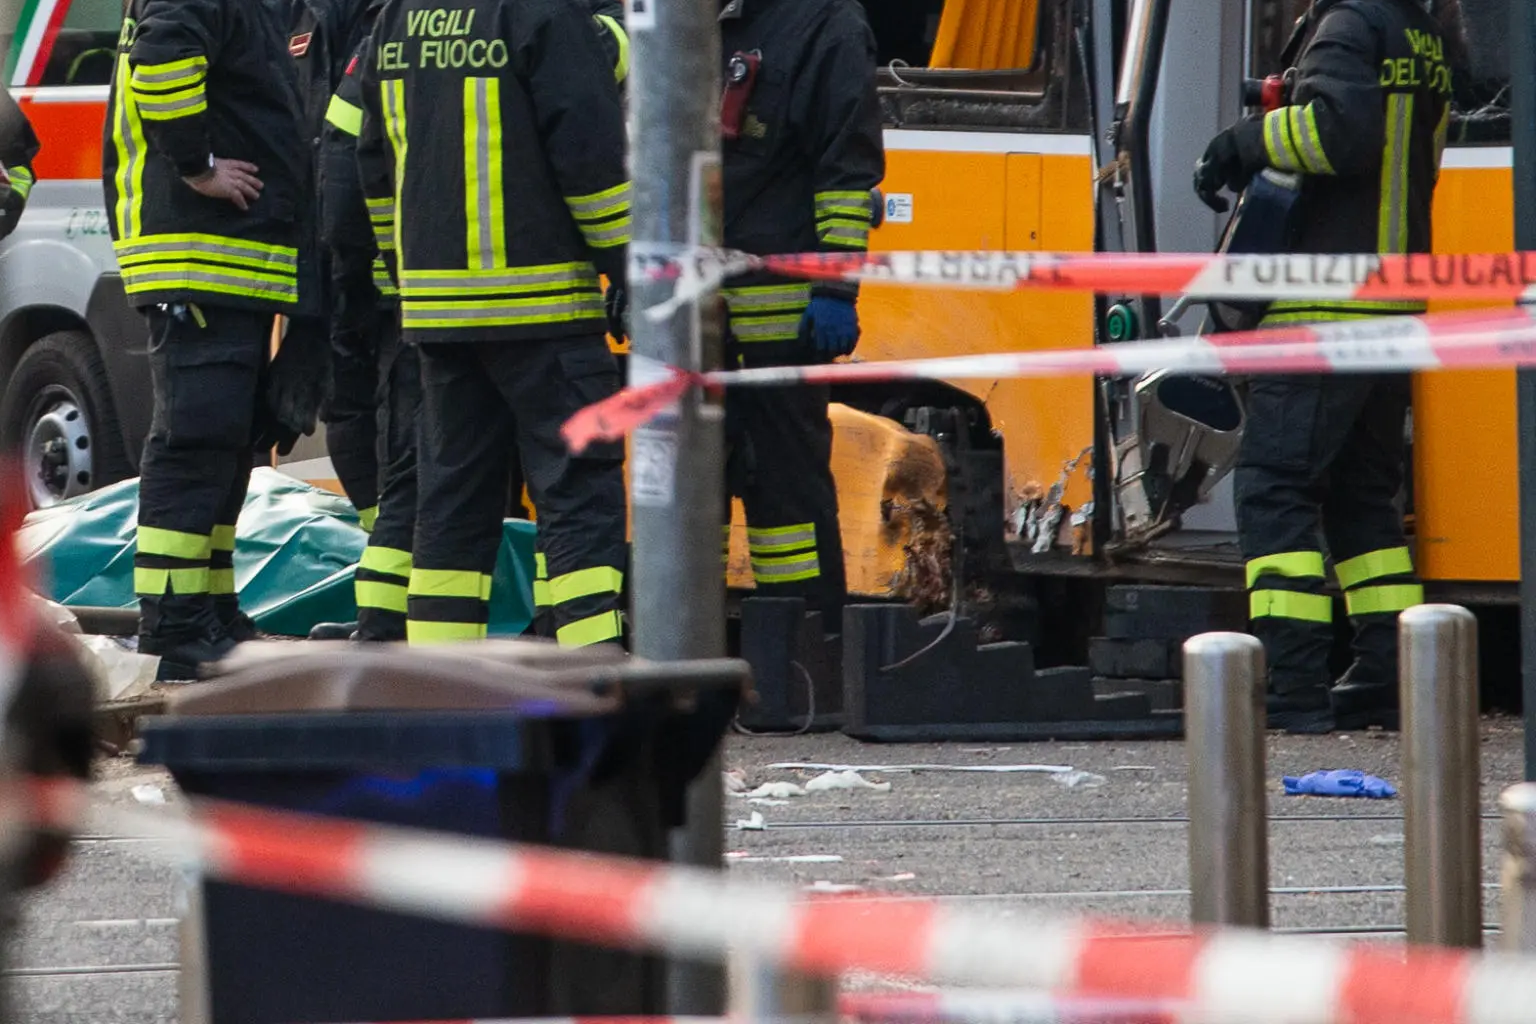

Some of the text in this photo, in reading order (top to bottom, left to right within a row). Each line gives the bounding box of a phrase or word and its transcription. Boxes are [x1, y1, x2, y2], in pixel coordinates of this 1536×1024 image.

[407, 8, 476, 37] VIGILI
[420, 39, 509, 68] FUOCO
[1380, 58, 1421, 86] DEL
[1223, 254, 1536, 286] POLIZIA LOCAL
